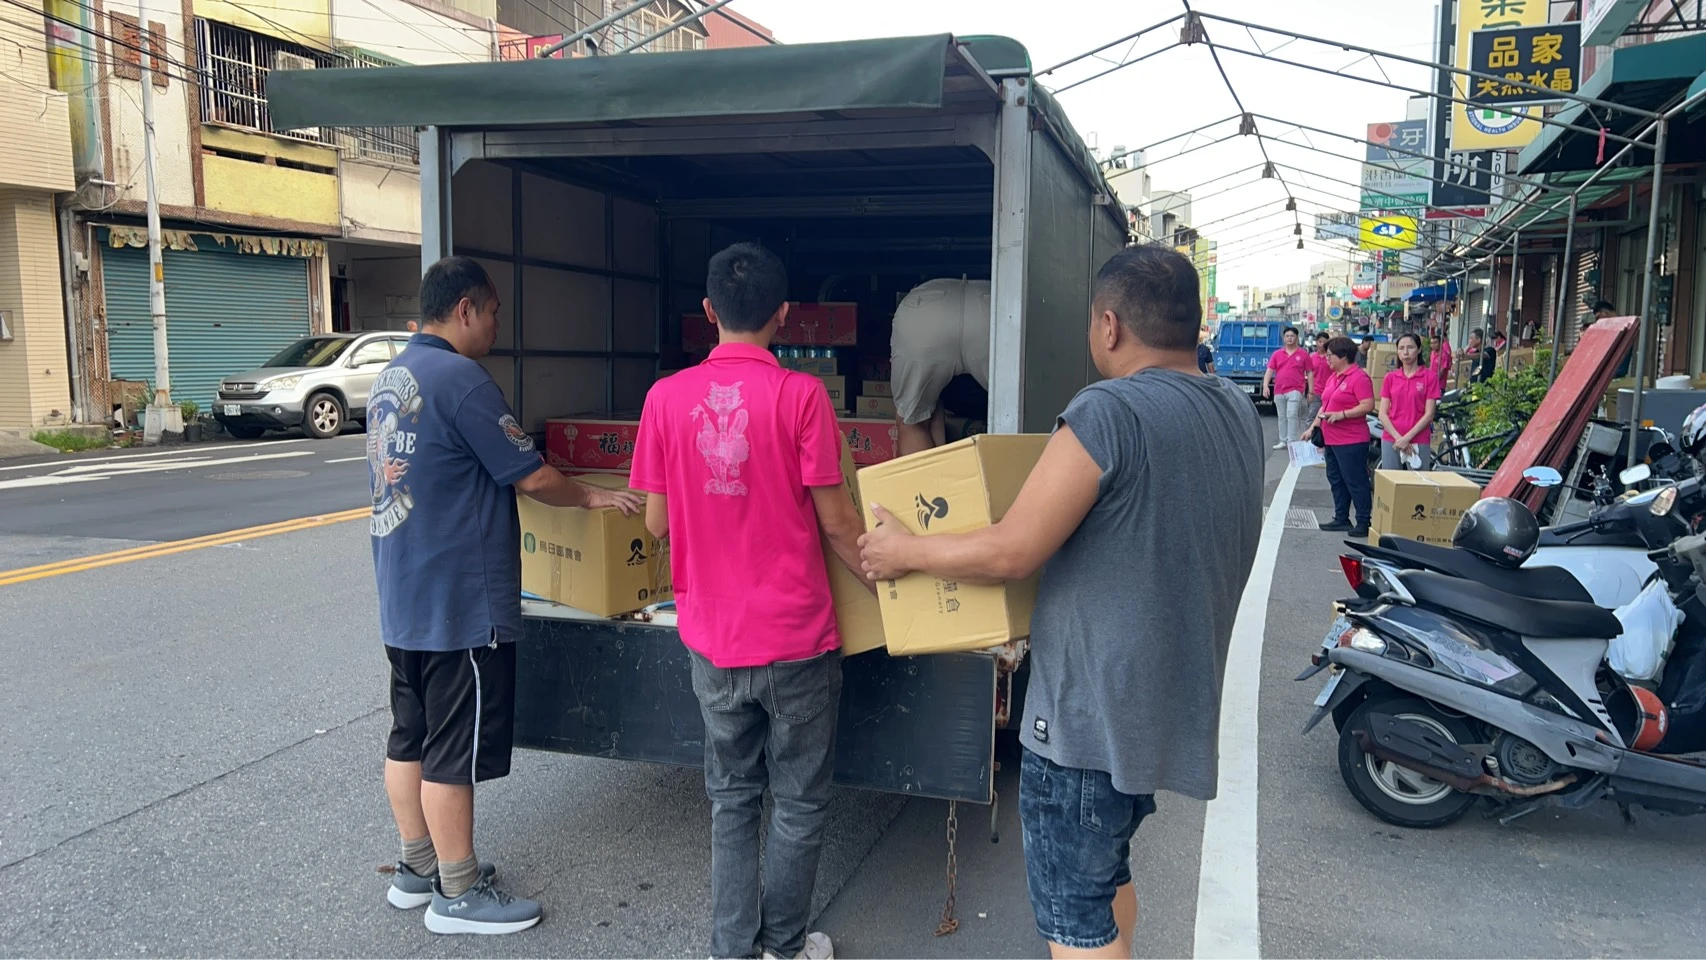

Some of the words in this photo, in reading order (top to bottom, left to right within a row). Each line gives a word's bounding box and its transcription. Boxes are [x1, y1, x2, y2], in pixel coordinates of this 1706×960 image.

[1488, 33, 1563, 68] 品家
[1477, 68, 1573, 97] 天然水晶
[1400, 128, 1423, 145] 牙
[1484, 126, 1507, 134] HEALTH
[395, 430, 417, 455] BE
[540, 541, 582, 562] 烏日區農會
[935, 582, 943, 614] Granary
[448, 901, 468, 913] FILA
